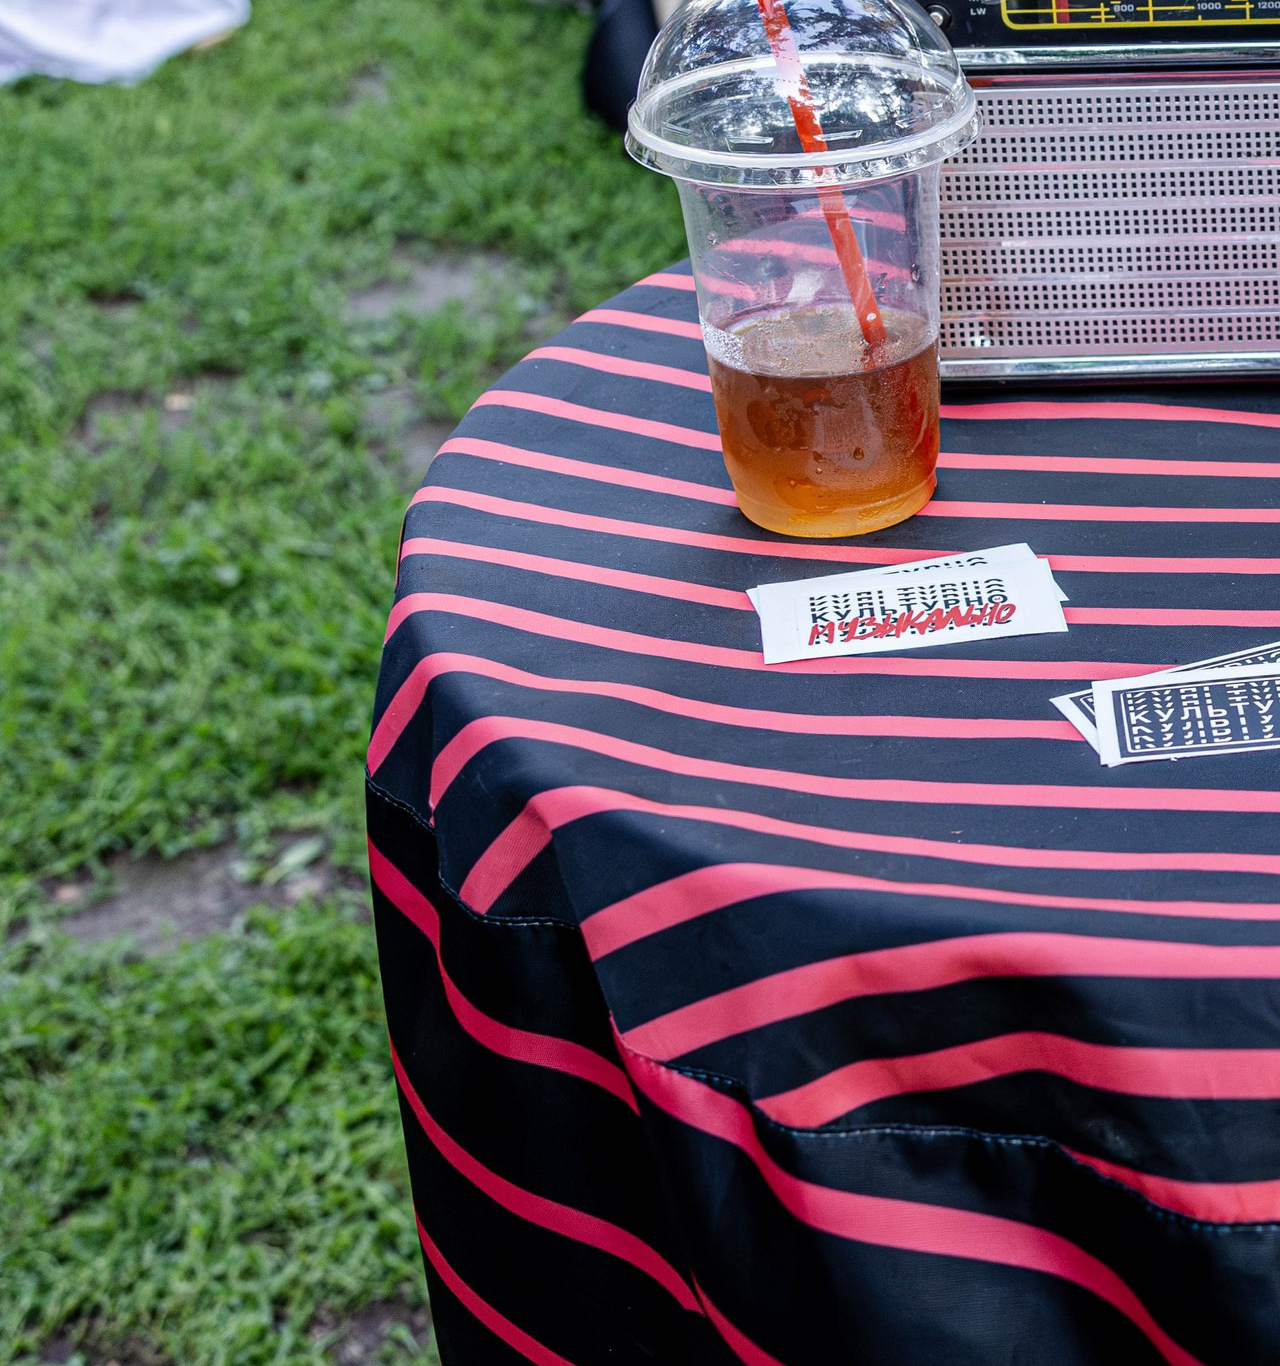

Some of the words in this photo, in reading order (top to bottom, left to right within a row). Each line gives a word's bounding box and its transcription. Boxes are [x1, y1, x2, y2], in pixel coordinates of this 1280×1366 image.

[970, 7, 987, 16] LW
[1112, 4, 1135, 13] 800
[1196, 2, 1222, 11] 1000
